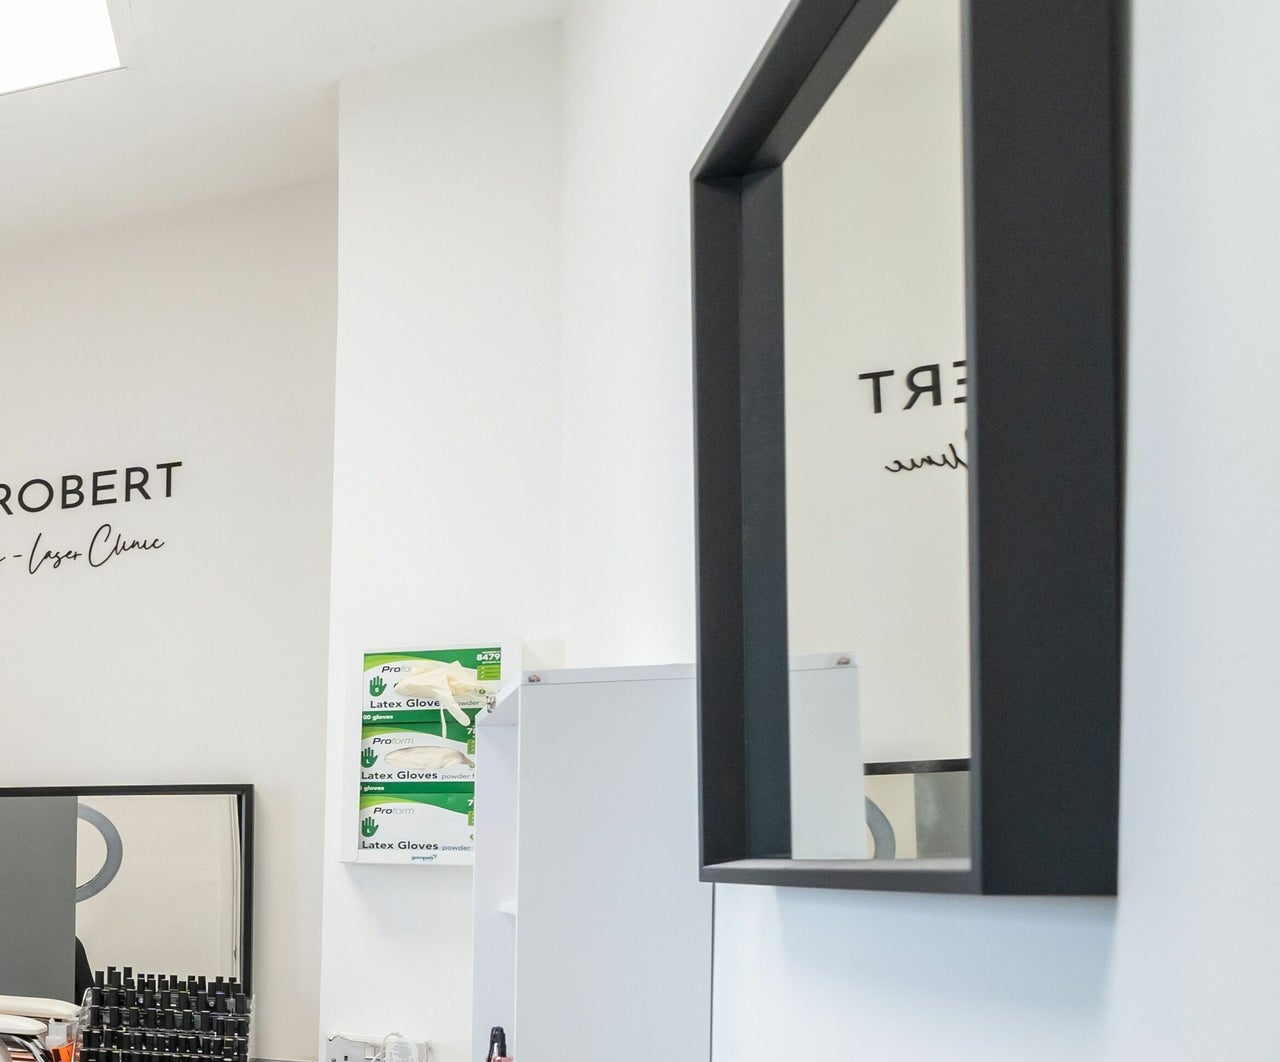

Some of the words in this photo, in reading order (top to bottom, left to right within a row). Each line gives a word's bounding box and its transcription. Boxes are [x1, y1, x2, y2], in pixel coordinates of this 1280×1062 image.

[28, 532, 82, 575] Laser
[88, 523, 166, 568] Clinic
[370, 700, 402, 709] Latex
[406, 698, 441, 707] Glove
[372, 737, 414, 745] Proform
[361, 771, 393, 779] Latex
[397, 770, 438, 779] Gloves
[373, 807, 415, 815] Proform
[362, 841, 394, 849] Latex
[397, 841, 439, 850] Gloves
